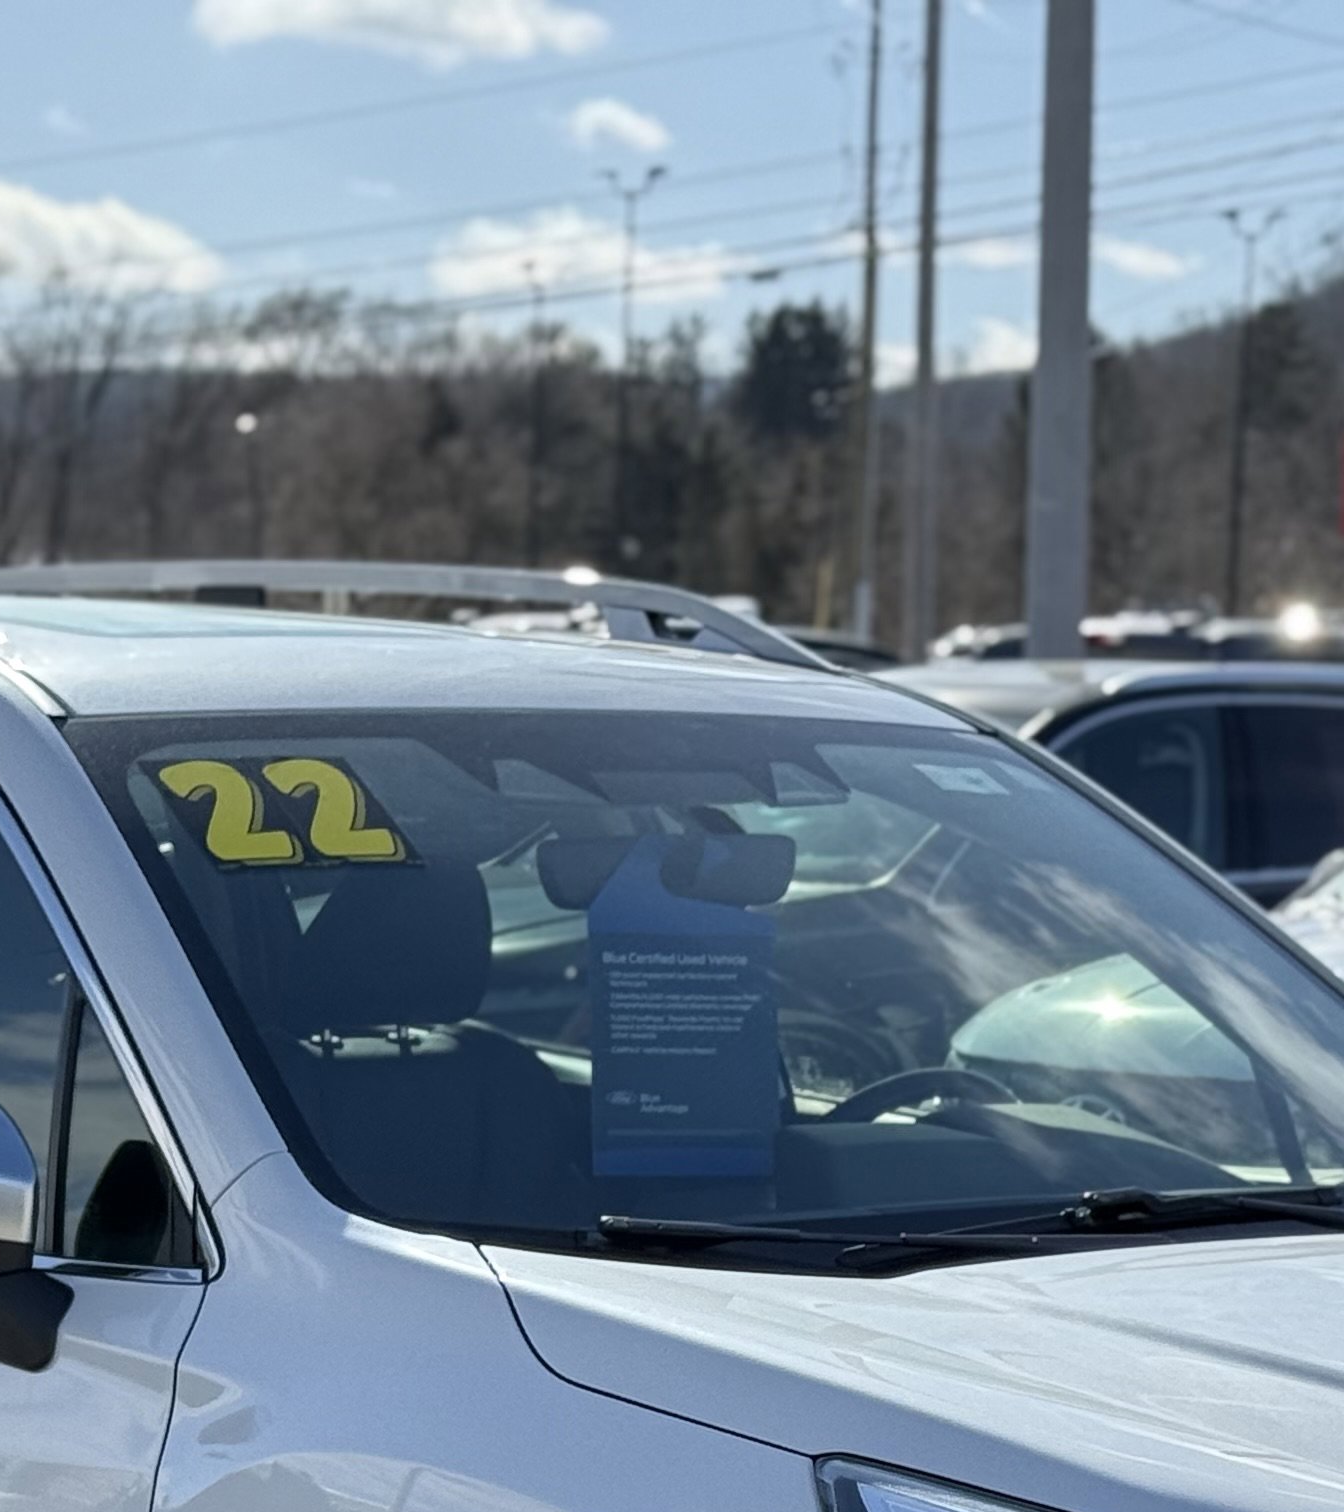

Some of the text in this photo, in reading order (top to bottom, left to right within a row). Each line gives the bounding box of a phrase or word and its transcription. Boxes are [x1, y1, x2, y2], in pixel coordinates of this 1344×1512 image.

[159, 759, 406, 866] 22
[602, 951, 627, 965] Blue
[628, 952, 676, 966] Certified
[677, 952, 706, 966] Used
